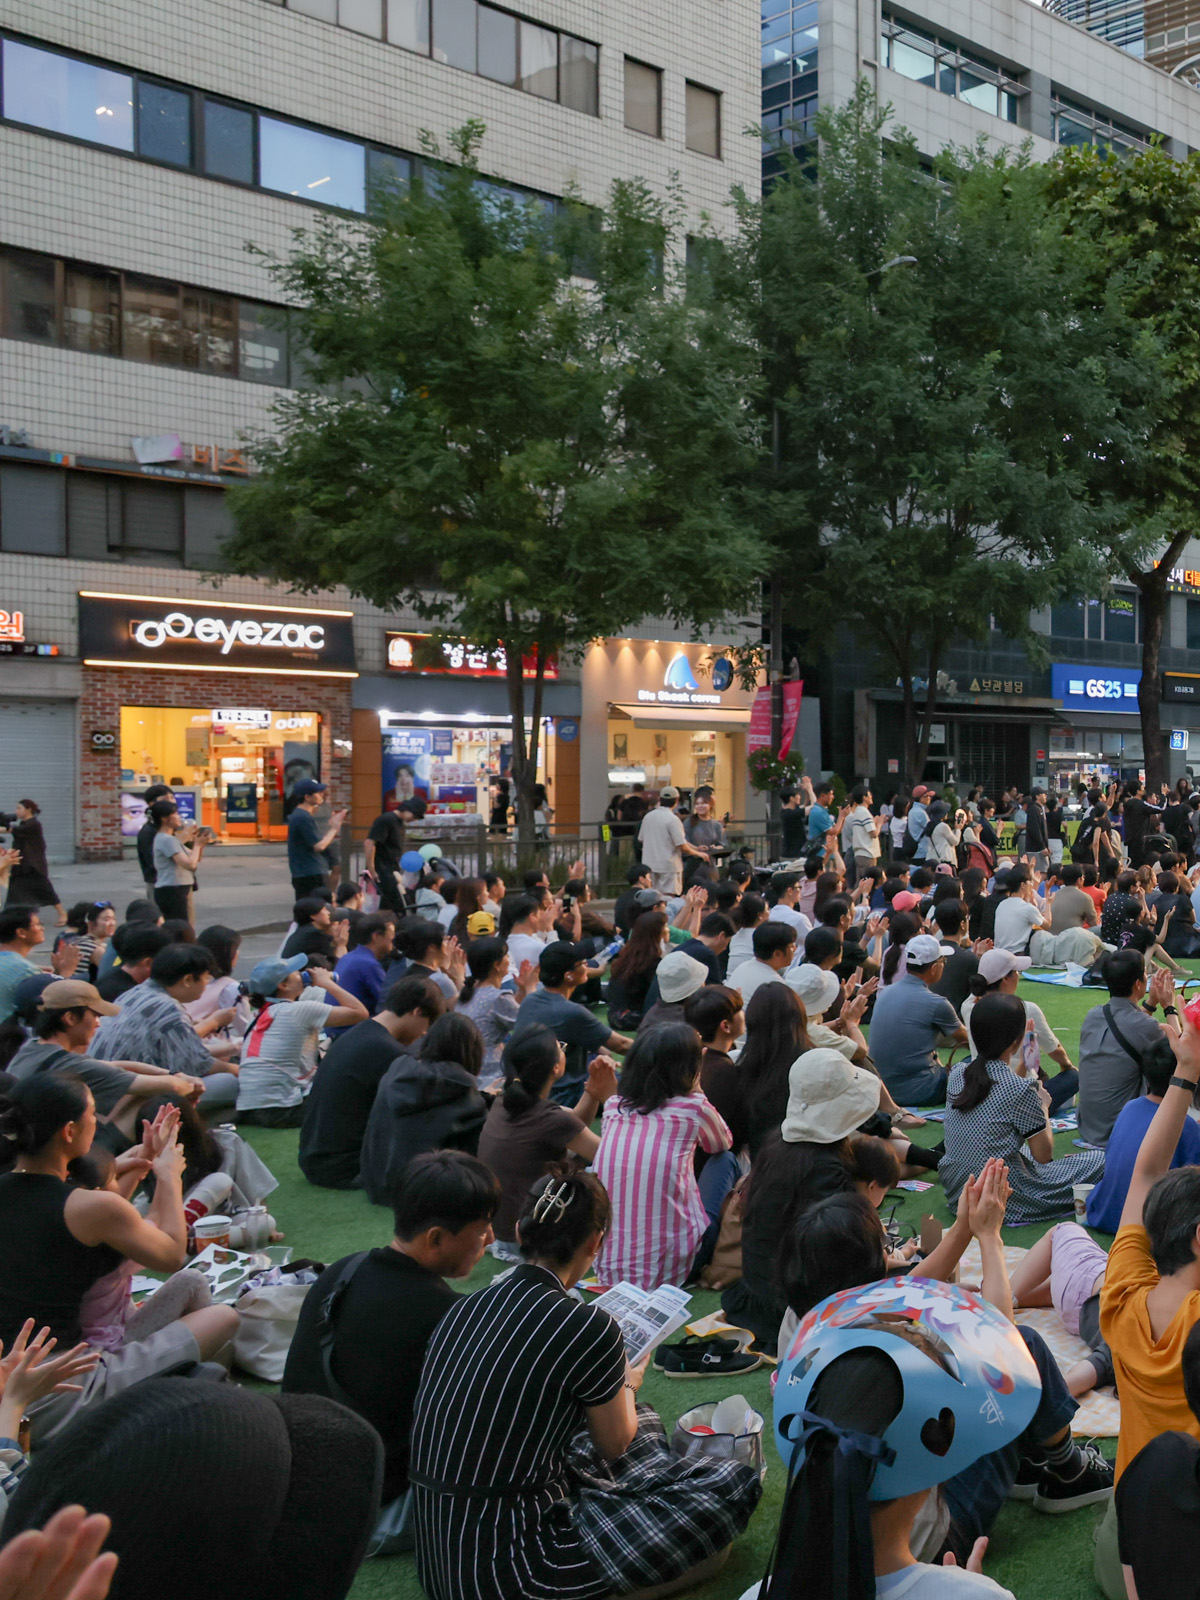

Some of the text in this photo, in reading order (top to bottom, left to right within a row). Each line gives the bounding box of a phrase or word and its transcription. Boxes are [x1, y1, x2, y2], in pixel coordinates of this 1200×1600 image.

[194, 617, 325, 654] eyezac
[982, 679, 1023, 693] 보광빌딩
[1086, 679, 1122, 698] GS25
